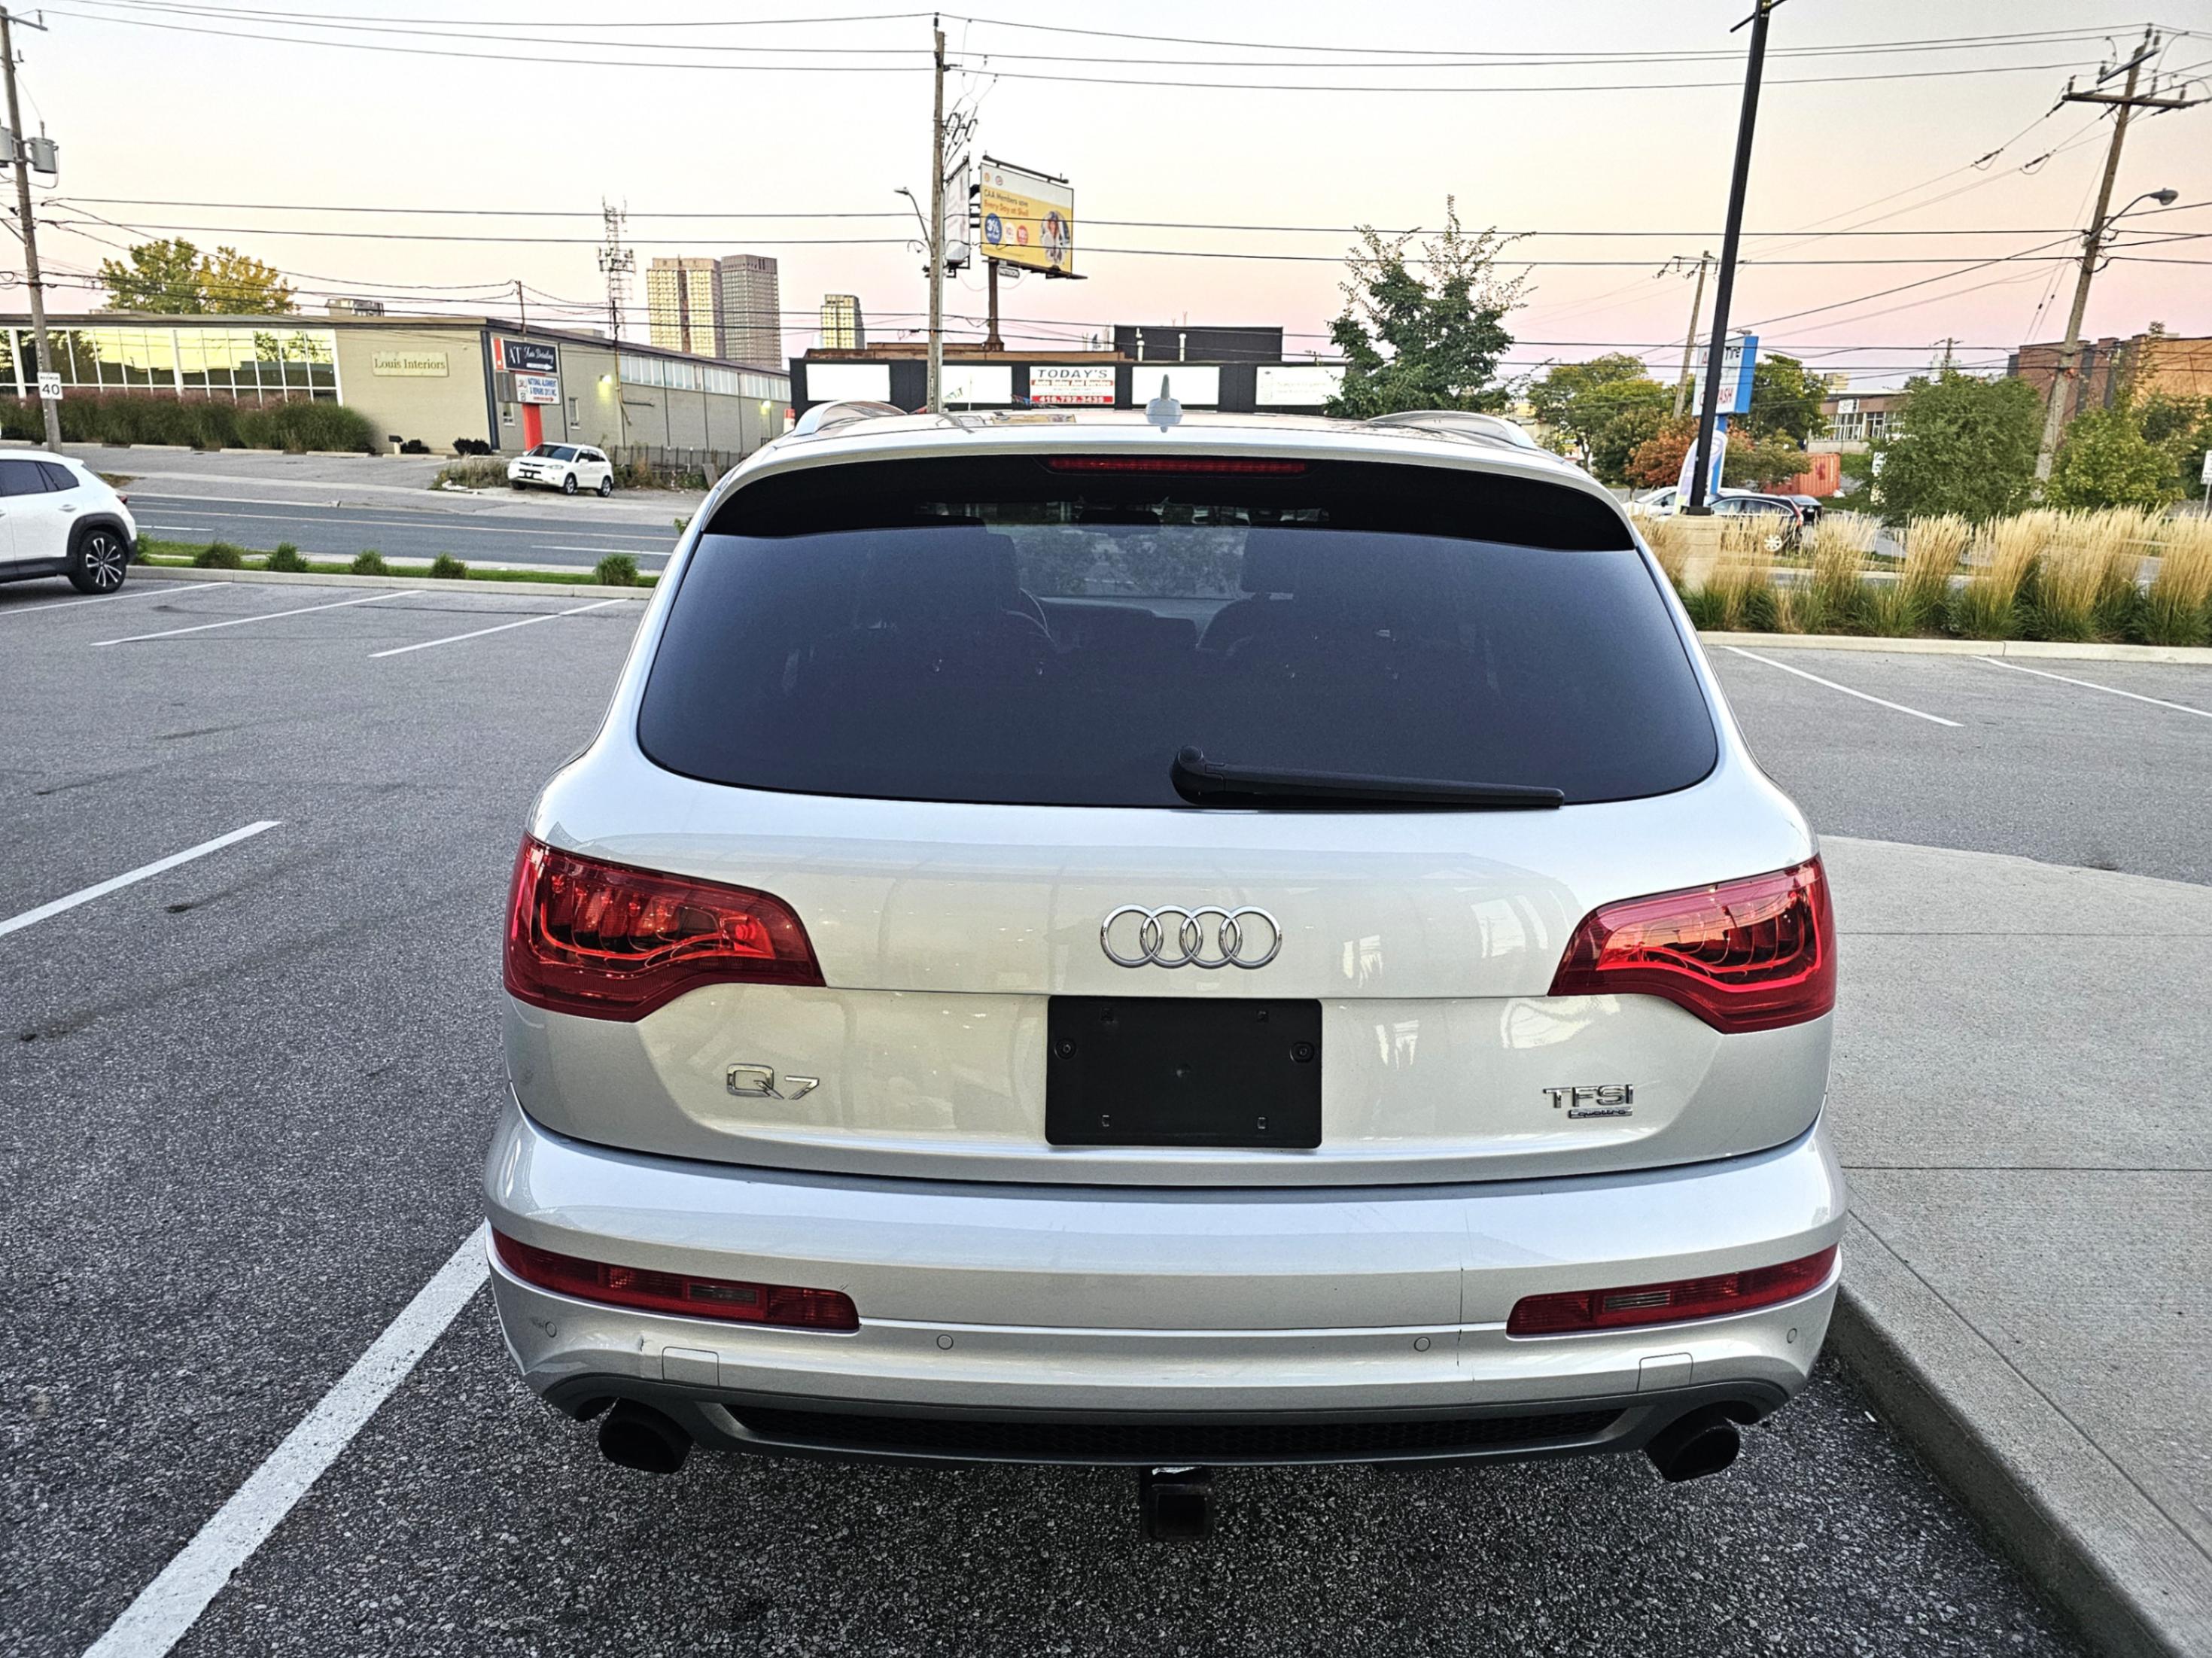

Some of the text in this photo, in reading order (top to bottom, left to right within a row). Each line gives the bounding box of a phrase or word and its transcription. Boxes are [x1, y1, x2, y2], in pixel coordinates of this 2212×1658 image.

[996, 192, 1018, 205] Members
[984, 199, 999, 211] Every
[374, 358, 446, 370] Louis Interiors
[1038, 369, 1108, 379] TODAY'S
[42, 384, 60, 395] 40
[726, 1063, 820, 1100] Q7
[1543, 1084, 1633, 1108] TFSI
[1578, 1109, 1626, 1118] quattro
